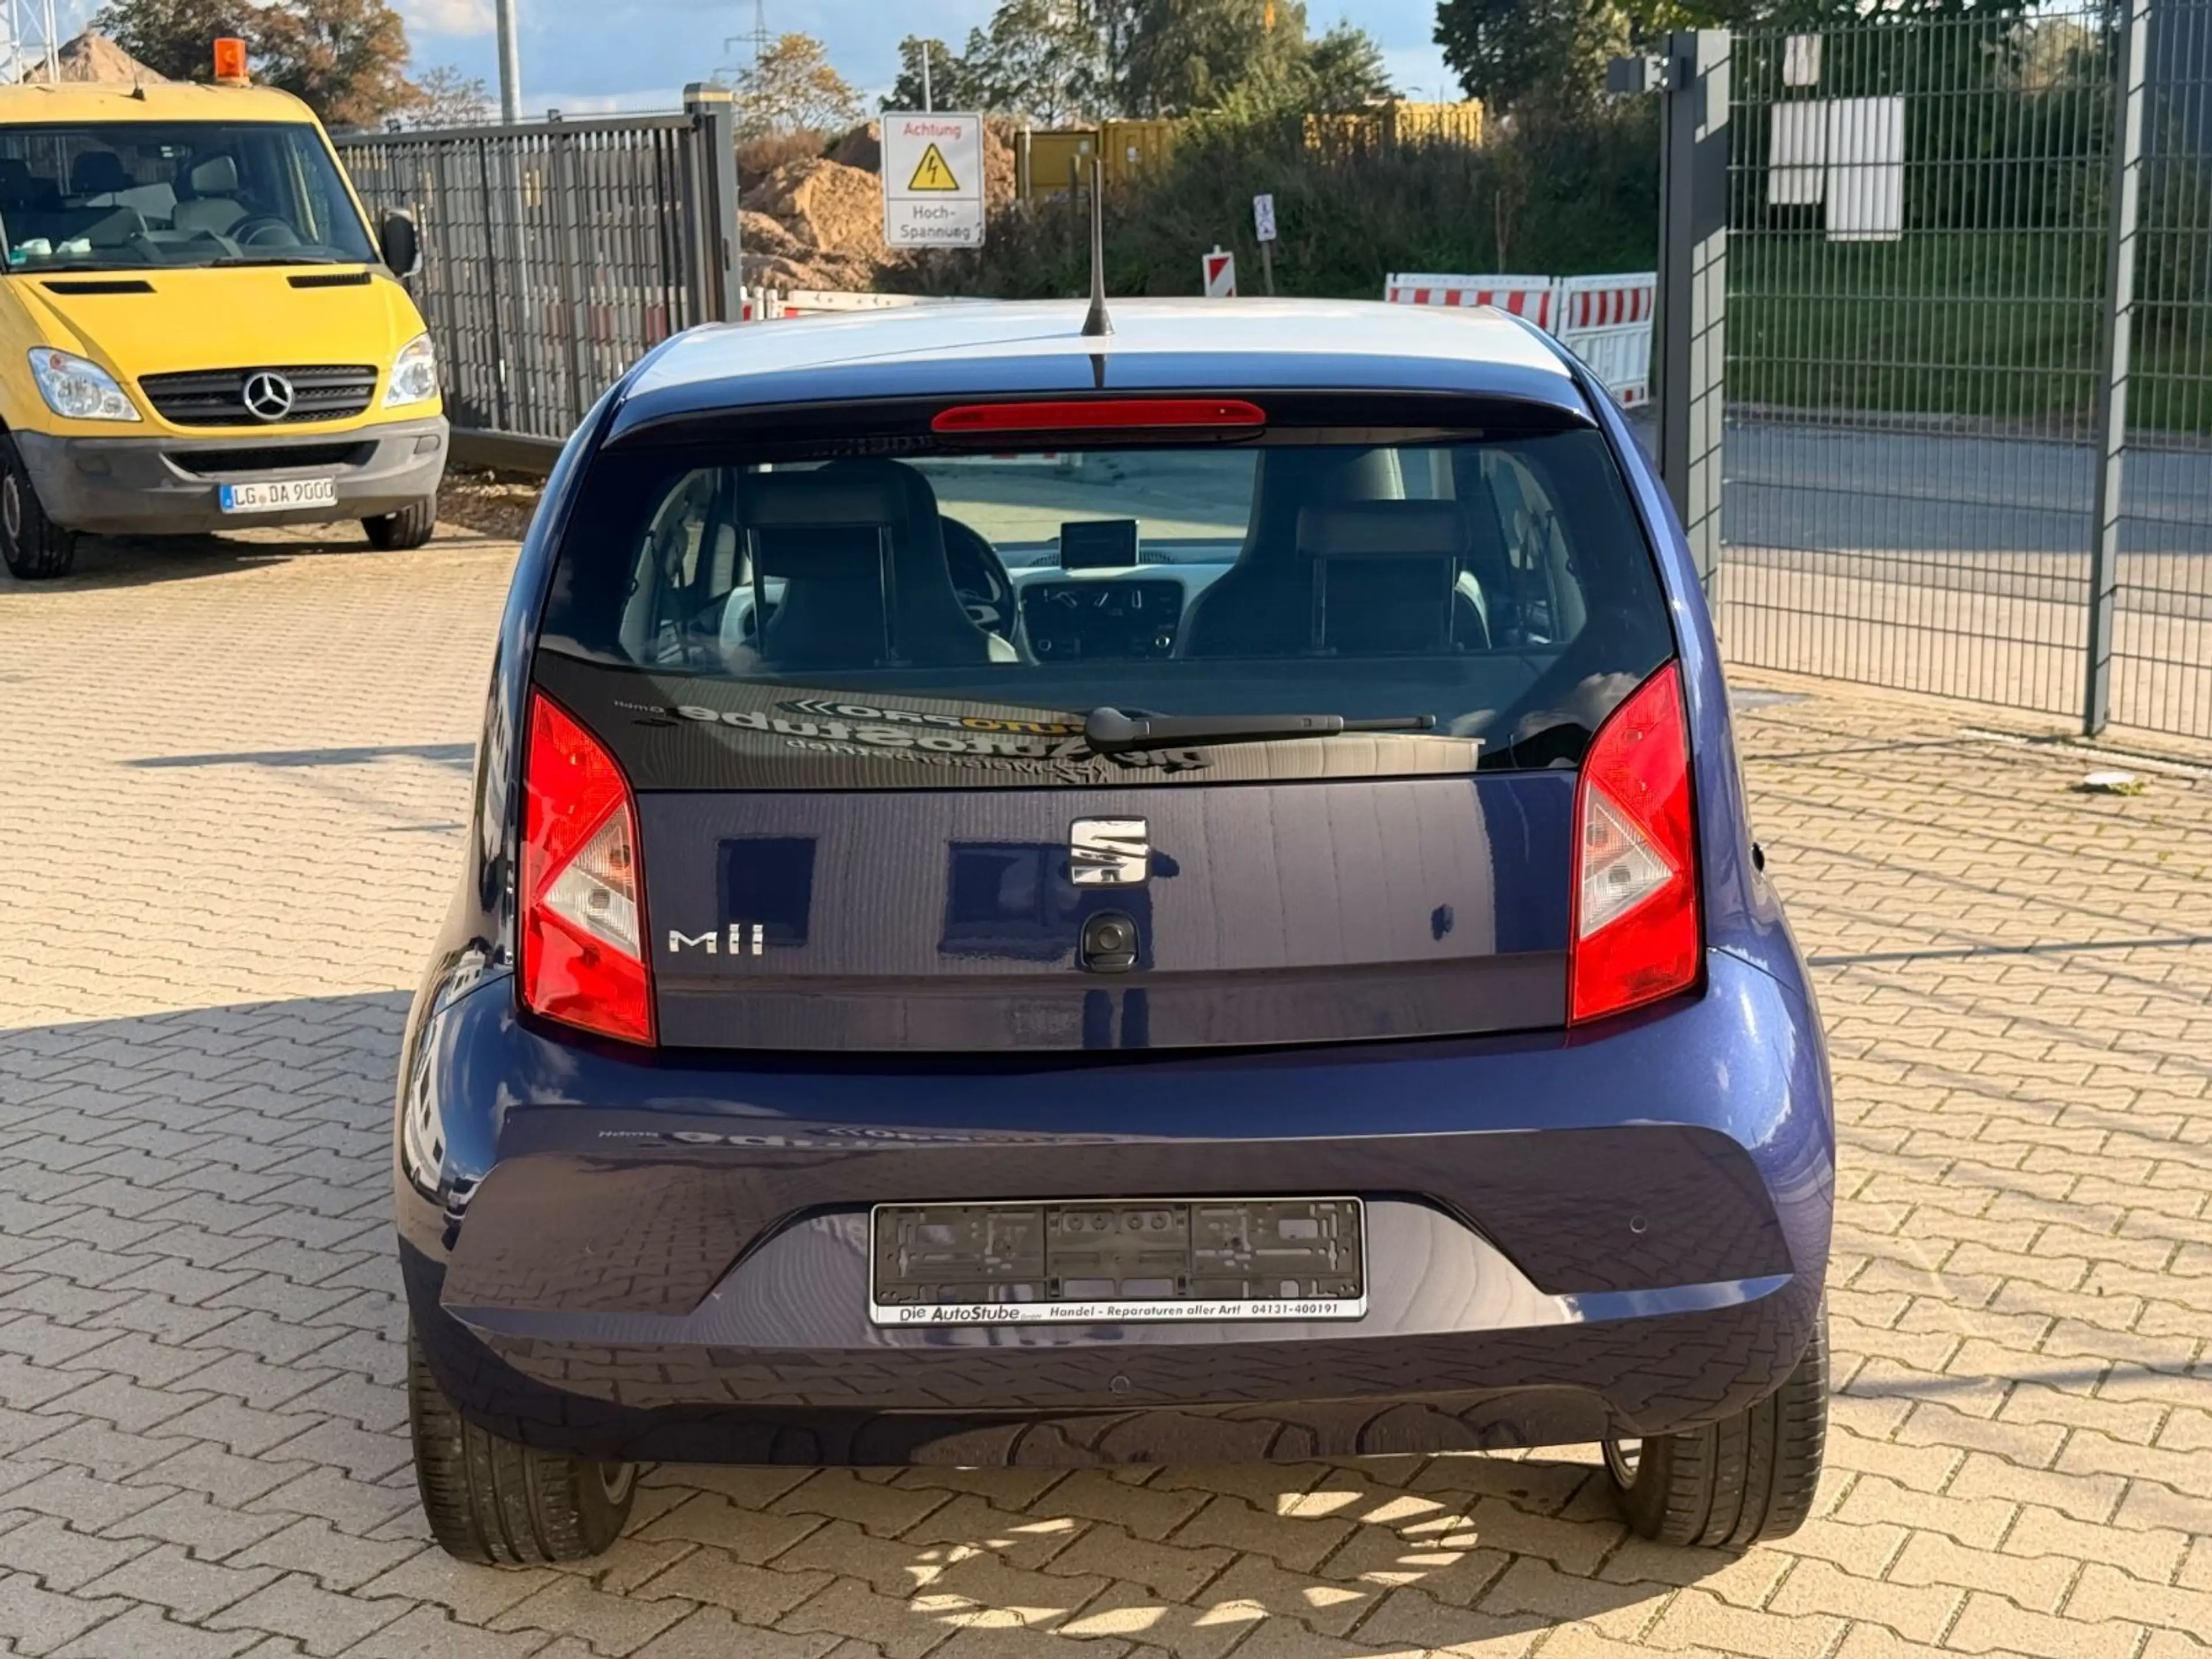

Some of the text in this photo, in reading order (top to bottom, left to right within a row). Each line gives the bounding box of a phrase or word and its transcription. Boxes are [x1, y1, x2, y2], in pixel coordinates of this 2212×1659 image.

[903, 122, 962, 139] Achtung
[912, 205, 956, 219] Hoch-
[900, 224, 971, 241] Spannung
[234, 482, 334, 506] LG DA 9000
[900, 1306, 926, 1321] Die
[931, 1305, 1020, 1320] AutoStube
[1050, 1306, 1094, 1316] Handel
[1107, 1306, 1183, 1317] Reparaturen
[1187, 1305, 1215, 1315] aller
[1218, 1305, 1241, 1315] Art!
[1252, 1304, 1338, 1315] 04131-400191
